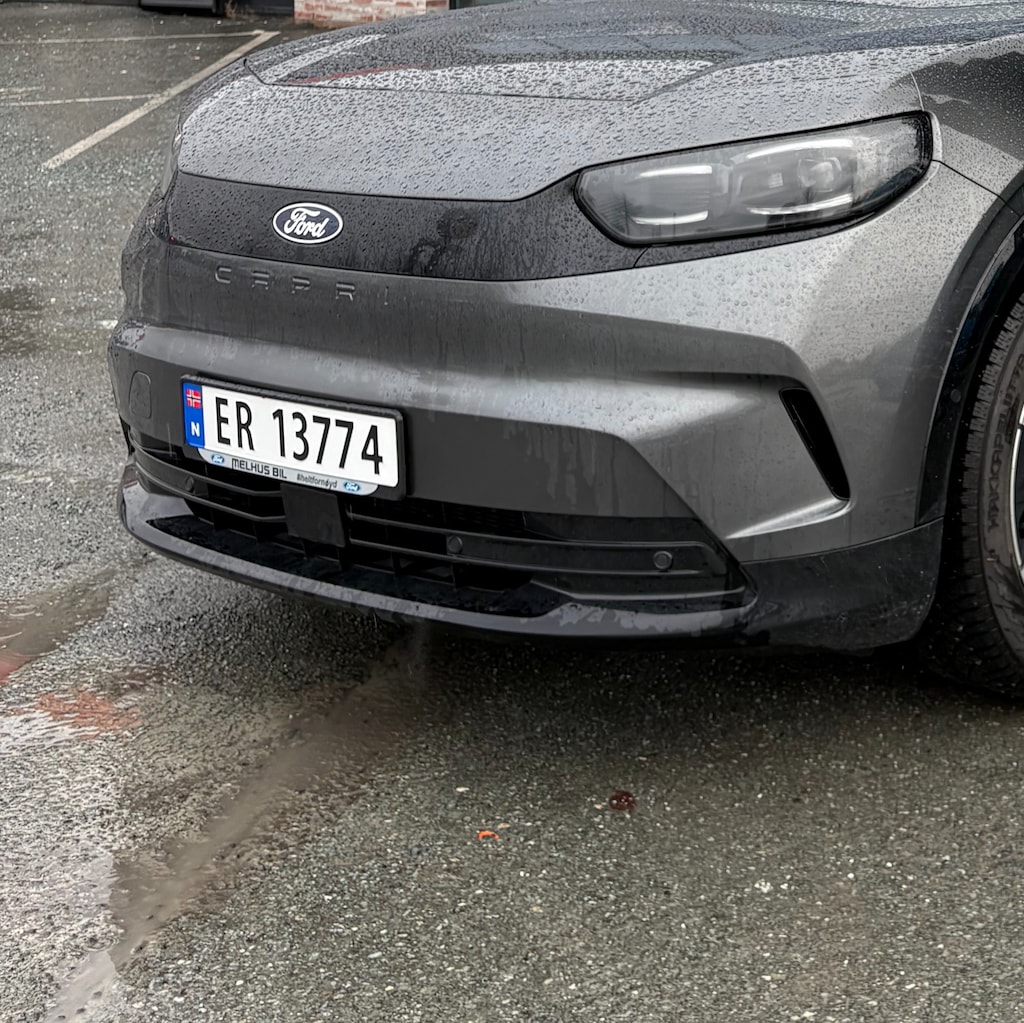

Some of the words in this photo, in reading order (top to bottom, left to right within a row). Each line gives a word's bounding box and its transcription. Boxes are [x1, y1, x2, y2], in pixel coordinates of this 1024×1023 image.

[283, 207, 330, 238] Ford
[190, 421, 201, 438] N
[215, 396, 256, 452] ER
[272, 408, 384, 476] 13774
[231, 457, 271, 476] MELHUS
[272, 467, 288, 479] BIL
